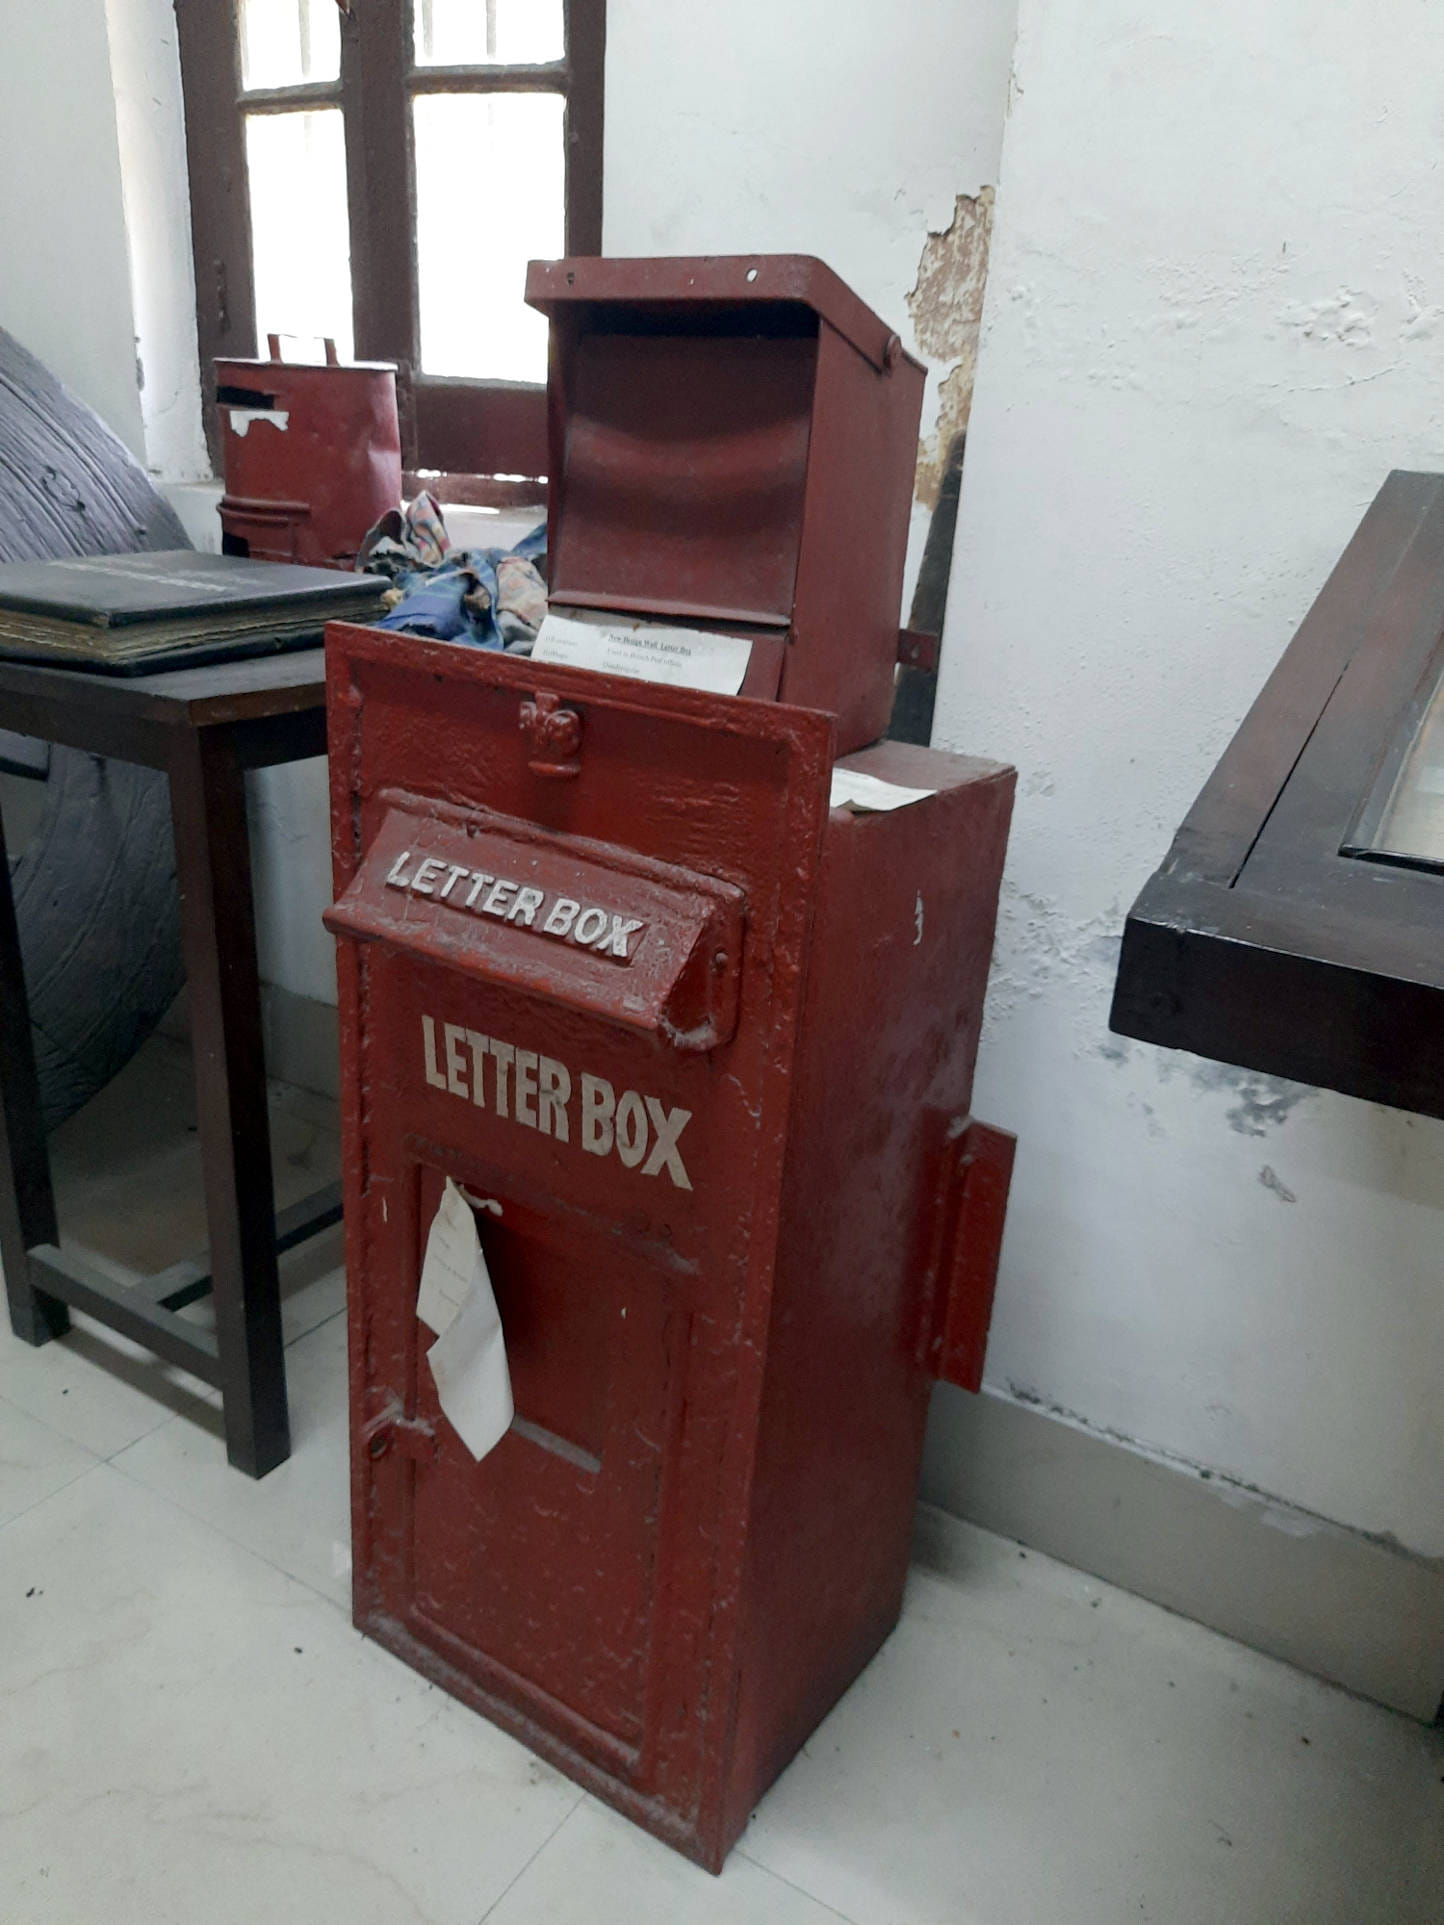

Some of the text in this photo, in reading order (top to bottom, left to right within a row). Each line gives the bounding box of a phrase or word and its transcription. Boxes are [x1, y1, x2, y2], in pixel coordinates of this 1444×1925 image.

[386, 851, 644, 958] LETTER BOX
[421, 1014, 693, 1191] LETTER BOX
